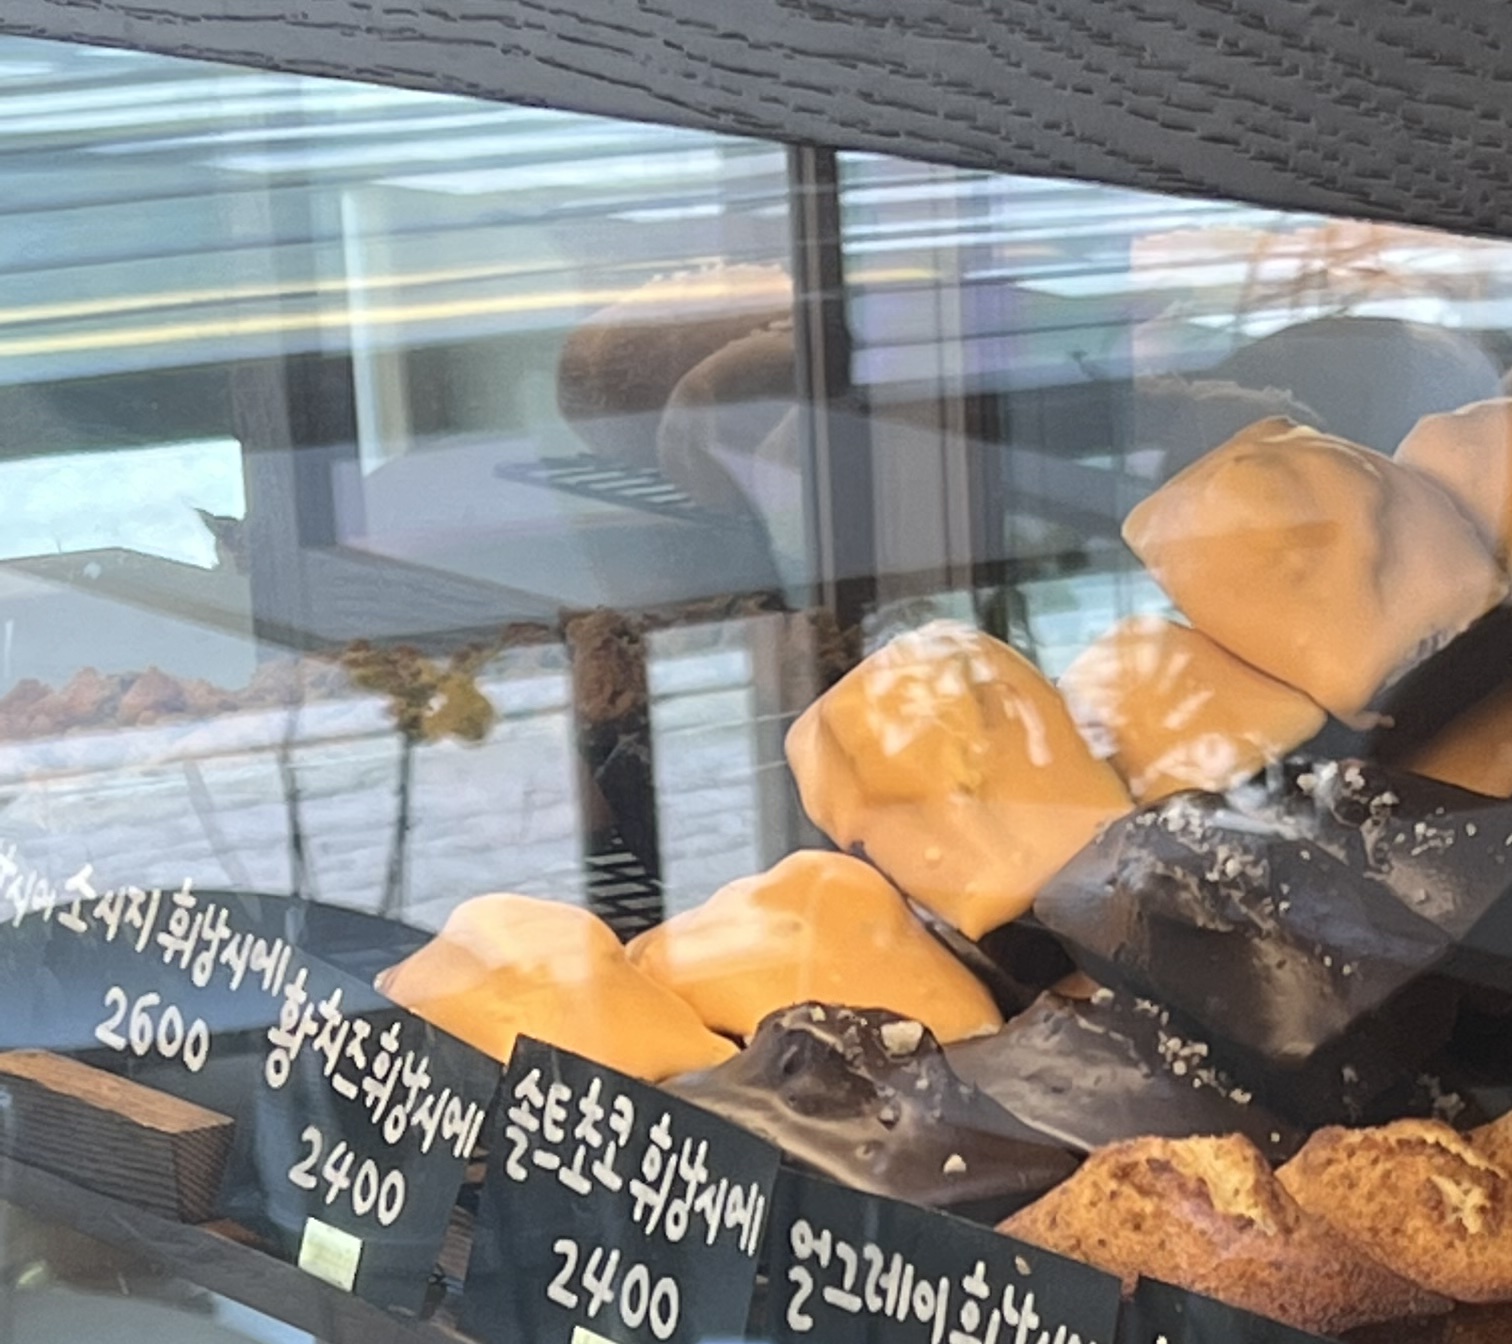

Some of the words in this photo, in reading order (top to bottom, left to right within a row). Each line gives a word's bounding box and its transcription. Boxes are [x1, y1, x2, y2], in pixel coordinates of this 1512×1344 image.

[157, 876, 292, 997] 휘낭시에
[96, 986, 210, 1072] 2600
[288, 1124, 406, 1226] 2400
[508, 1068, 635, 1196] 솔트초코
[629, 1112, 766, 1257] 휘낭시에
[547, 1238, 680, 1340] 2400
